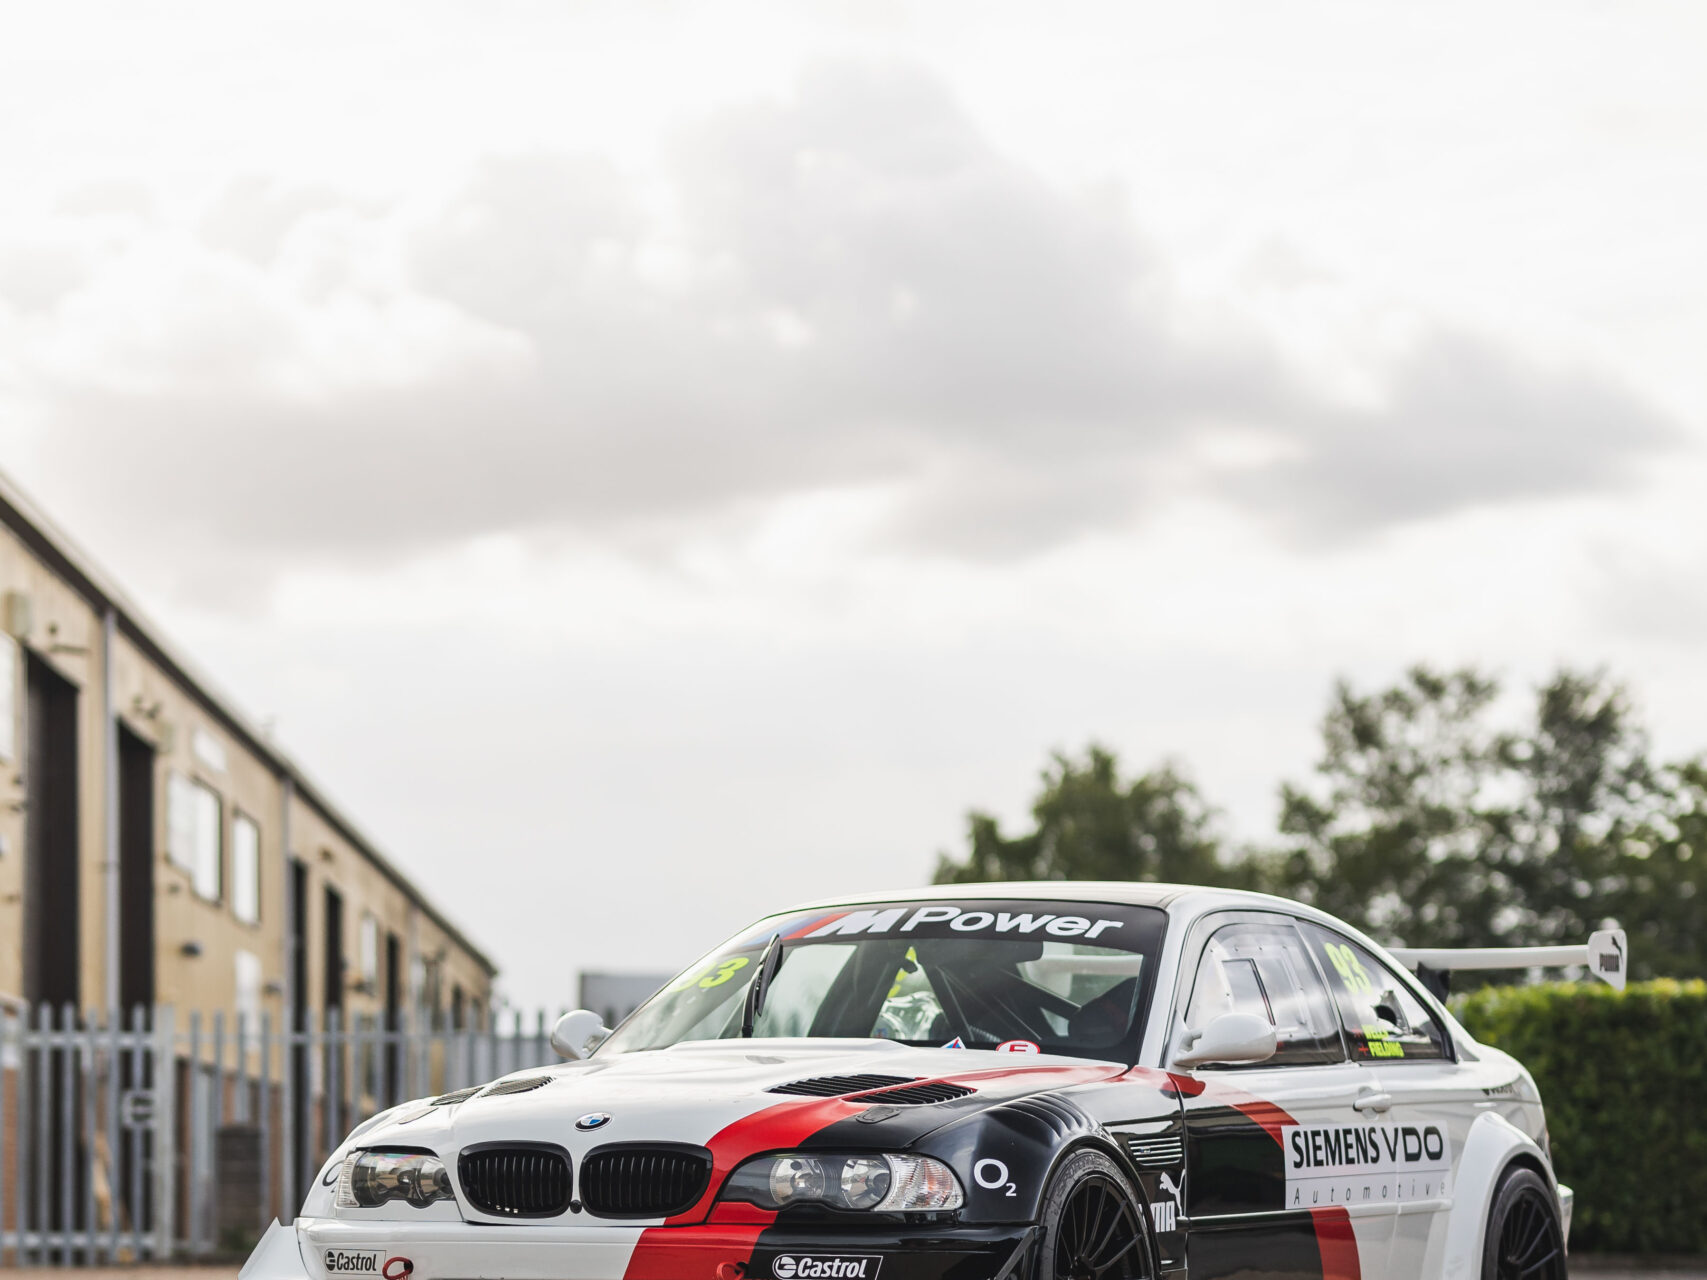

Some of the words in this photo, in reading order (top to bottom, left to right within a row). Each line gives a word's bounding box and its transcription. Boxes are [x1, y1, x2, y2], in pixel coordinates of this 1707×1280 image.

[1291, 1126, 1380, 1169] SIEMENS
[1381, 1126, 1444, 1162] VDO
[336, 1252, 377, 1271] Castrol
[797, 1257, 867, 1278] Castrol
